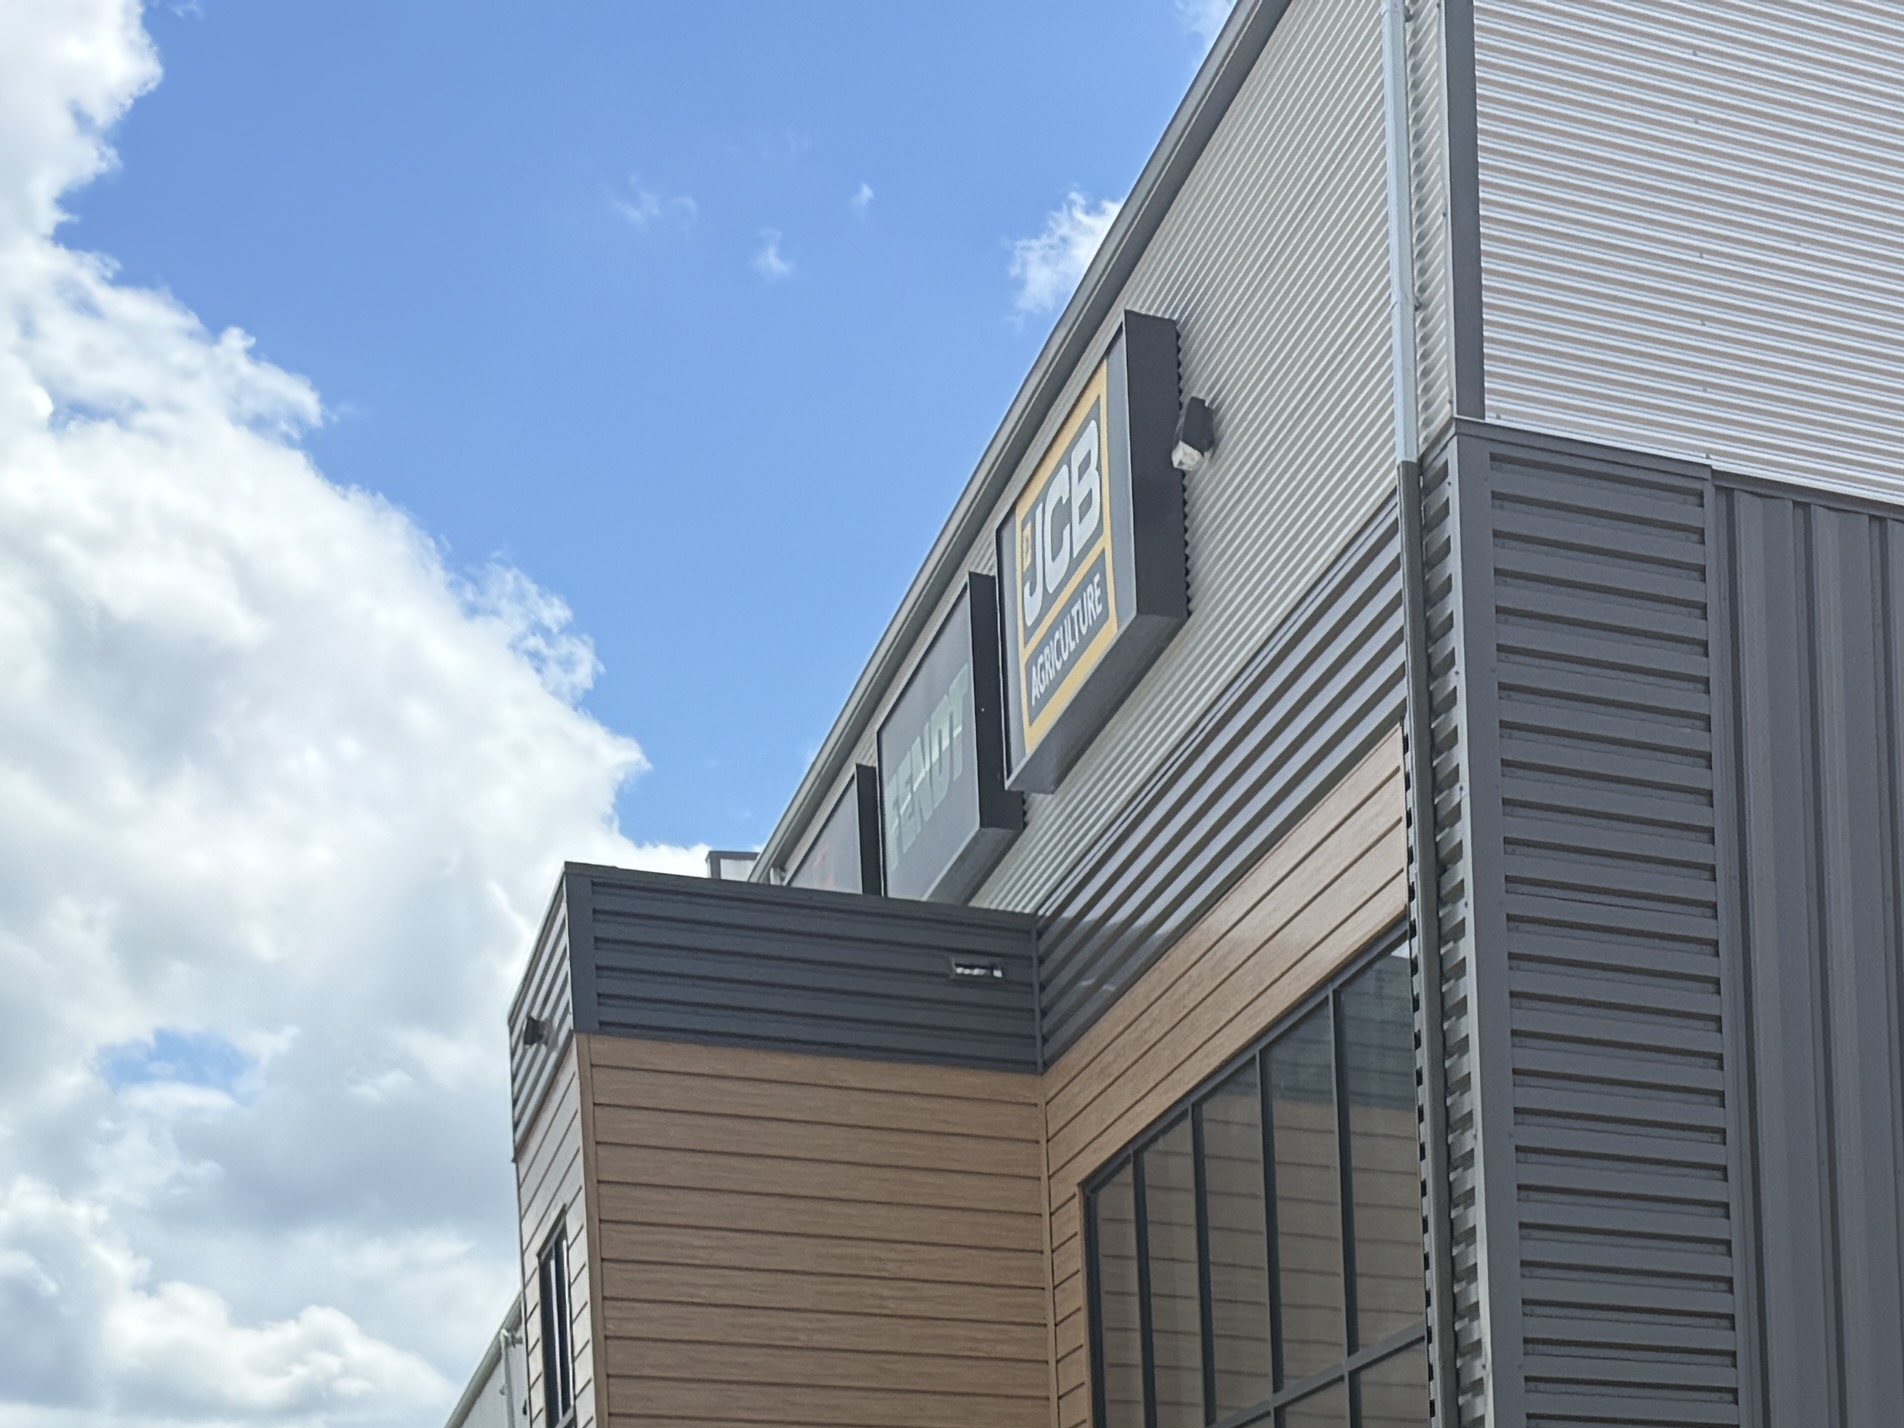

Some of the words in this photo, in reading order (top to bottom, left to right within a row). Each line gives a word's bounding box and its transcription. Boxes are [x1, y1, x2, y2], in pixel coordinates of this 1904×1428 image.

[1023, 418, 1100, 627] JCB
[1030, 571, 1104, 708] AGRICULTURE
[886, 662, 970, 872] FENDT
